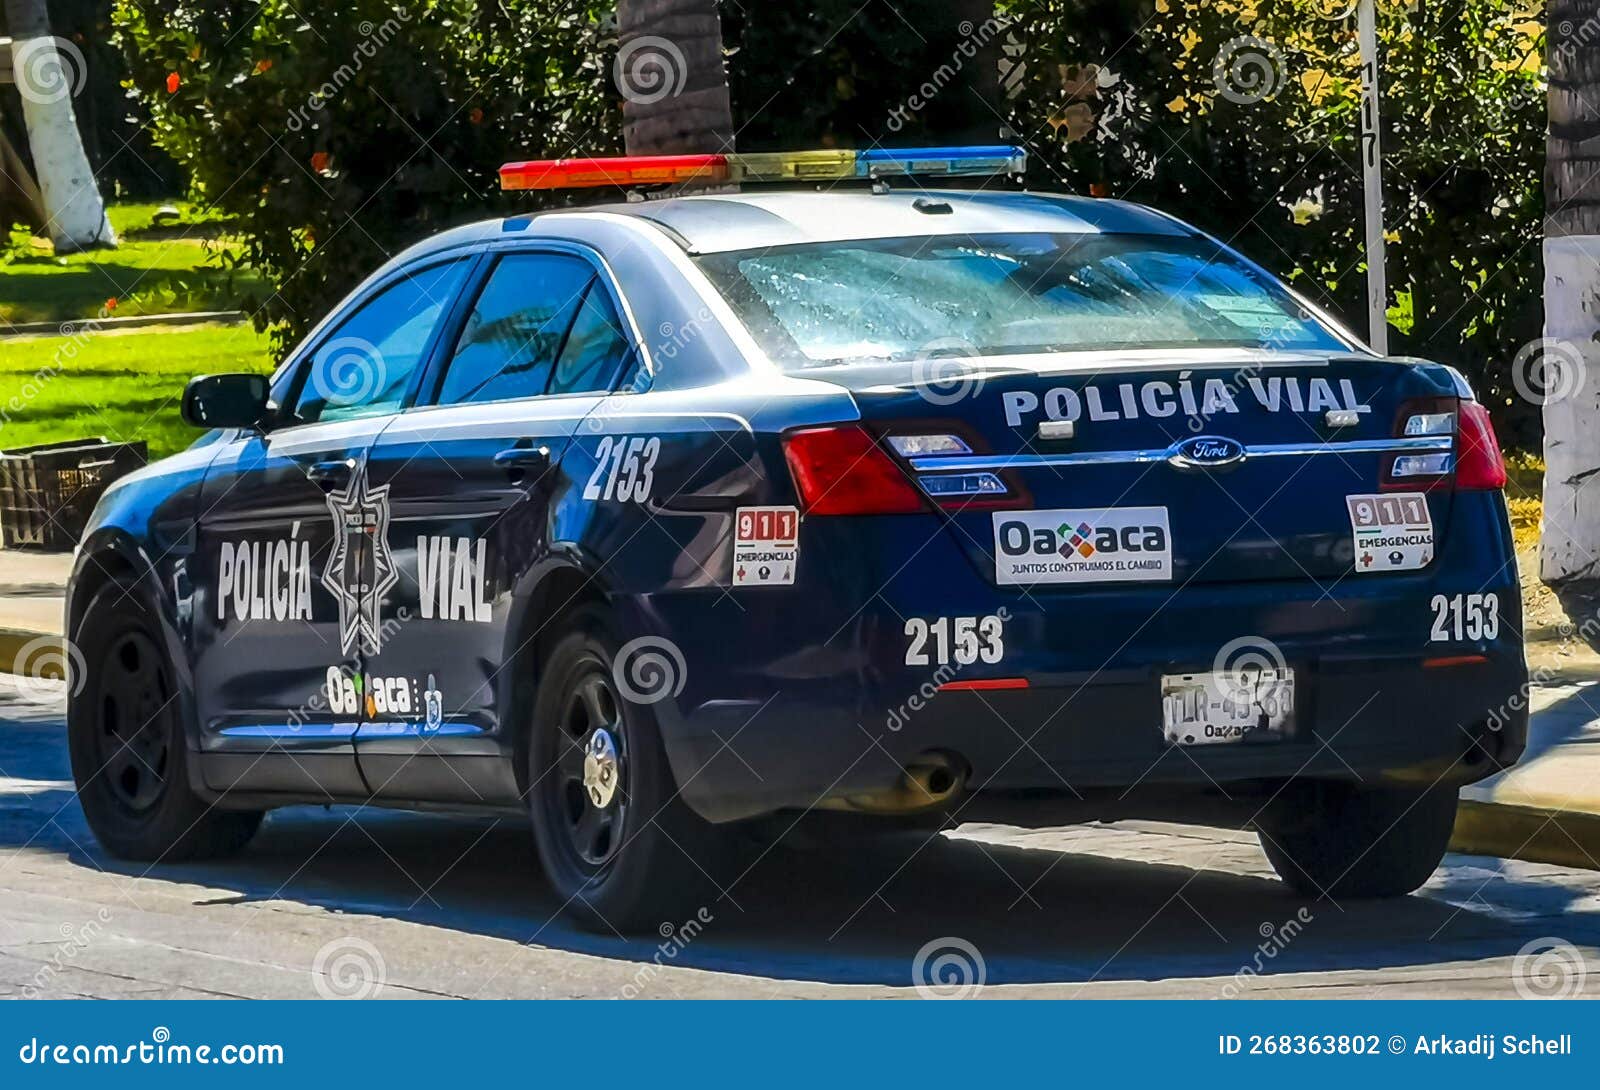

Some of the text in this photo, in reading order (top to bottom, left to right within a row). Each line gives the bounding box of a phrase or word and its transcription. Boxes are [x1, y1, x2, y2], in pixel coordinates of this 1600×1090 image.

[1002, 371, 1372, 427] POLICÍA VIAL
[1193, 441, 1228, 458] Ford
[583, 436, 660, 503] 2153
[740, 515, 791, 537] 911
[1356, 501, 1421, 524] 911
[1359, 535, 1433, 548] EMERGENCIAS
[217, 521, 492, 622] POLICÍA VIAL
[1012, 559, 1162, 574] JUNTOS CONSTRUIMOS EL CAMBIO
[1430, 593, 1499, 641] 2153
[904, 615, 1004, 666] 2153
